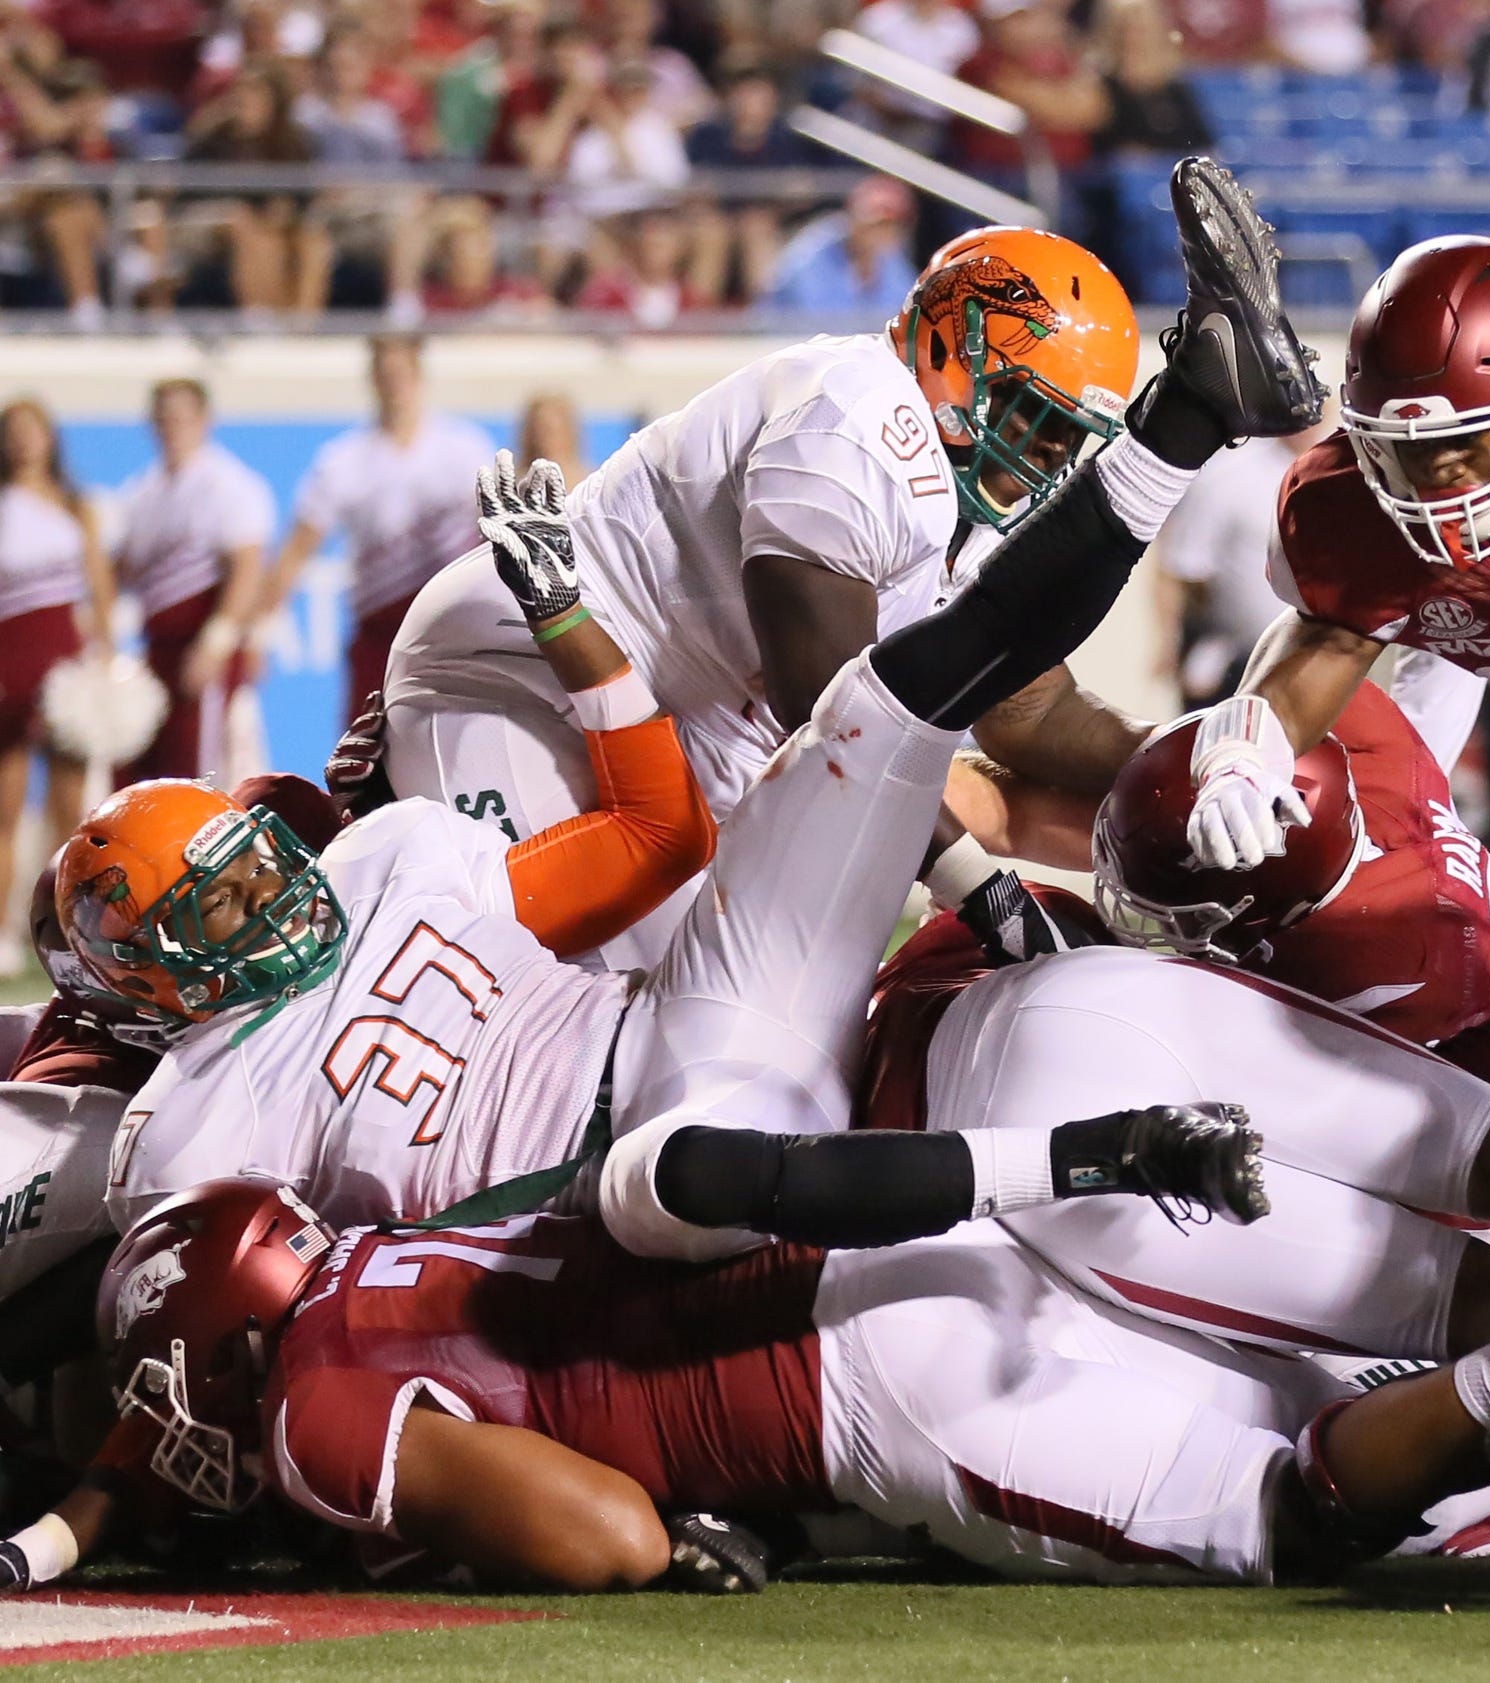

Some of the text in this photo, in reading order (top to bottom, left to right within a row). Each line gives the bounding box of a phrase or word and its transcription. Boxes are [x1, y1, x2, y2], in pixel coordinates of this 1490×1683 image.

[881, 404, 949, 499] 97
[1423, 602, 1469, 629] SEC
[194, 818, 227, 849] Riddell
[320, 918, 503, 1147] 37
[106, 1110, 154, 1188] 7
